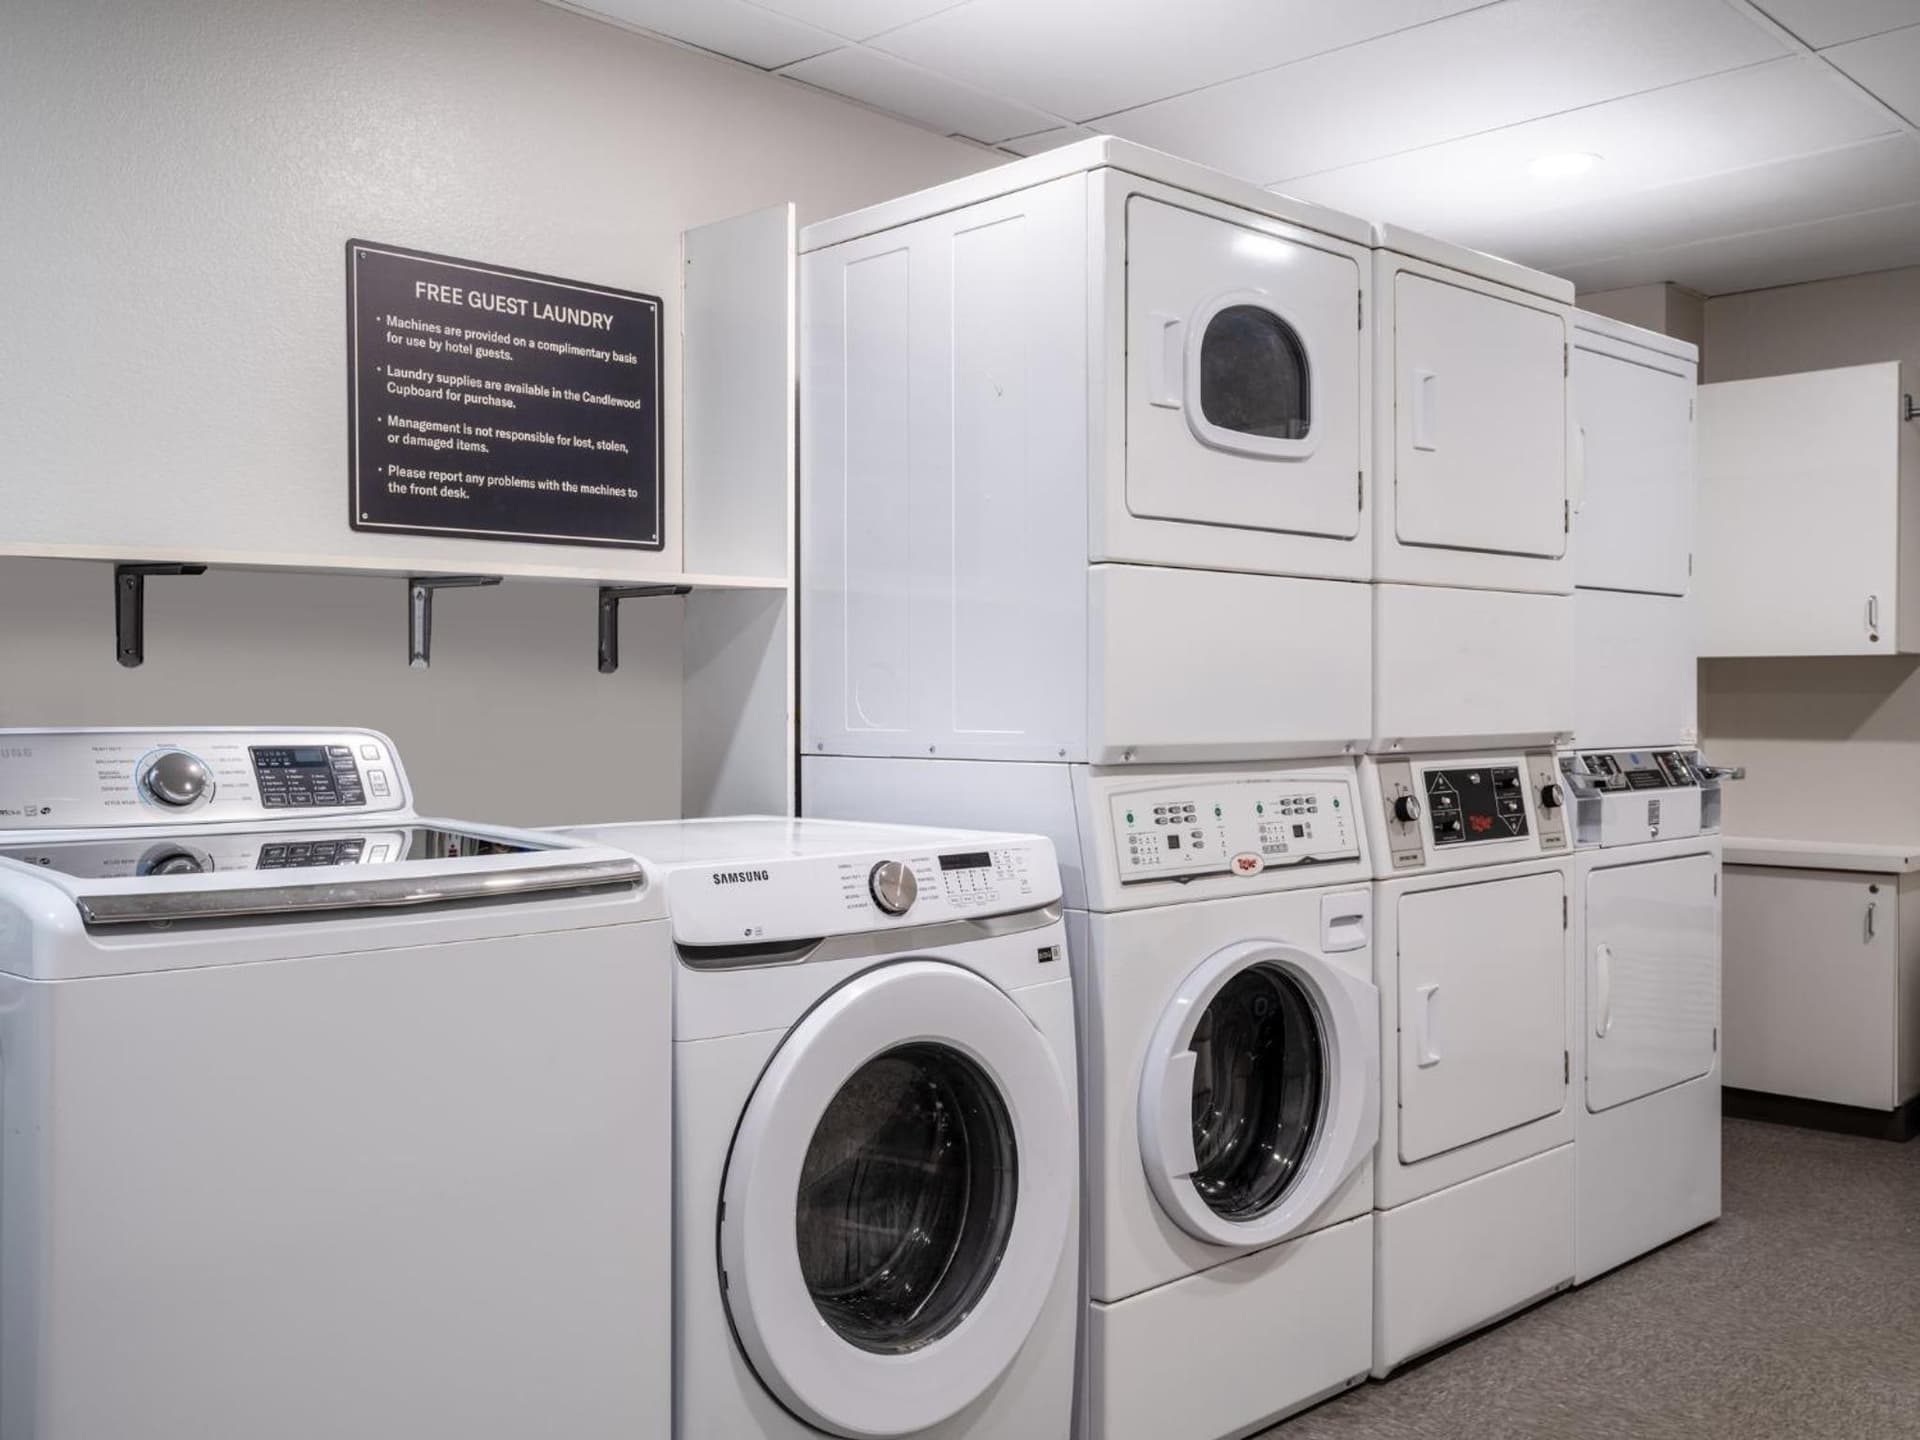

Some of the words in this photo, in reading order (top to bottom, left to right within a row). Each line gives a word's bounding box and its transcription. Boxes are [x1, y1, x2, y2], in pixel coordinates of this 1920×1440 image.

[416, 281, 462, 306] FREE
[468, 291, 528, 316] GUEST
[533, 302, 613, 331] LAUNDRY
[386, 315, 441, 334] Machines
[444, 325, 461, 336] are
[465, 327, 510, 343] provided
[513, 335, 526, 346] on
[529, 339, 535, 347] a
[537, 338, 610, 361] complimentary
[613, 350, 637, 364] basis
[386, 332, 403, 344] for
[407, 337, 426, 348] use
[429, 336, 442, 352] by
[445, 340, 473, 354] hotel
[476, 344, 512, 360] guests.
[387, 366, 433, 383] Laundry
[436, 372, 482, 389] supplies
[485, 379, 502, 390] are
[504, 380, 549, 397] available
[552, 387, 561, 398] in
[564, 389, 580, 401] the
[583, 391, 641, 410] Candlewood
[387, 383, 443, 400] Cupboard
[446, 389, 461, 401] for
[465, 392, 516, 408] purchase.
[388, 416, 460, 435] Management
[463, 423, 472, 434] is
[475, 425, 493, 437] not
[495, 427, 554, 447] responsible
[557, 434, 571, 446] for
[574, 437, 594, 450] lost,
[597, 440, 628, 454] stolen,
[388, 434, 400, 444] or
[403, 435, 453, 453] damaged
[457, 440, 489, 453] items.
[388, 465, 426, 479] Please
[429, 470, 463, 484] report
[466, 474, 484, 486] any
[487, 473, 535, 489] problems
[538, 478, 559, 490] with
[562, 480, 578, 492] the
[581, 482, 625, 497] machines
[628, 486, 638, 497] to
[388, 482, 407, 495] the
[410, 484, 437, 497] front
[440, 486, 469, 499] desk.
[712, 870, 769, 885] SAMSUNG
